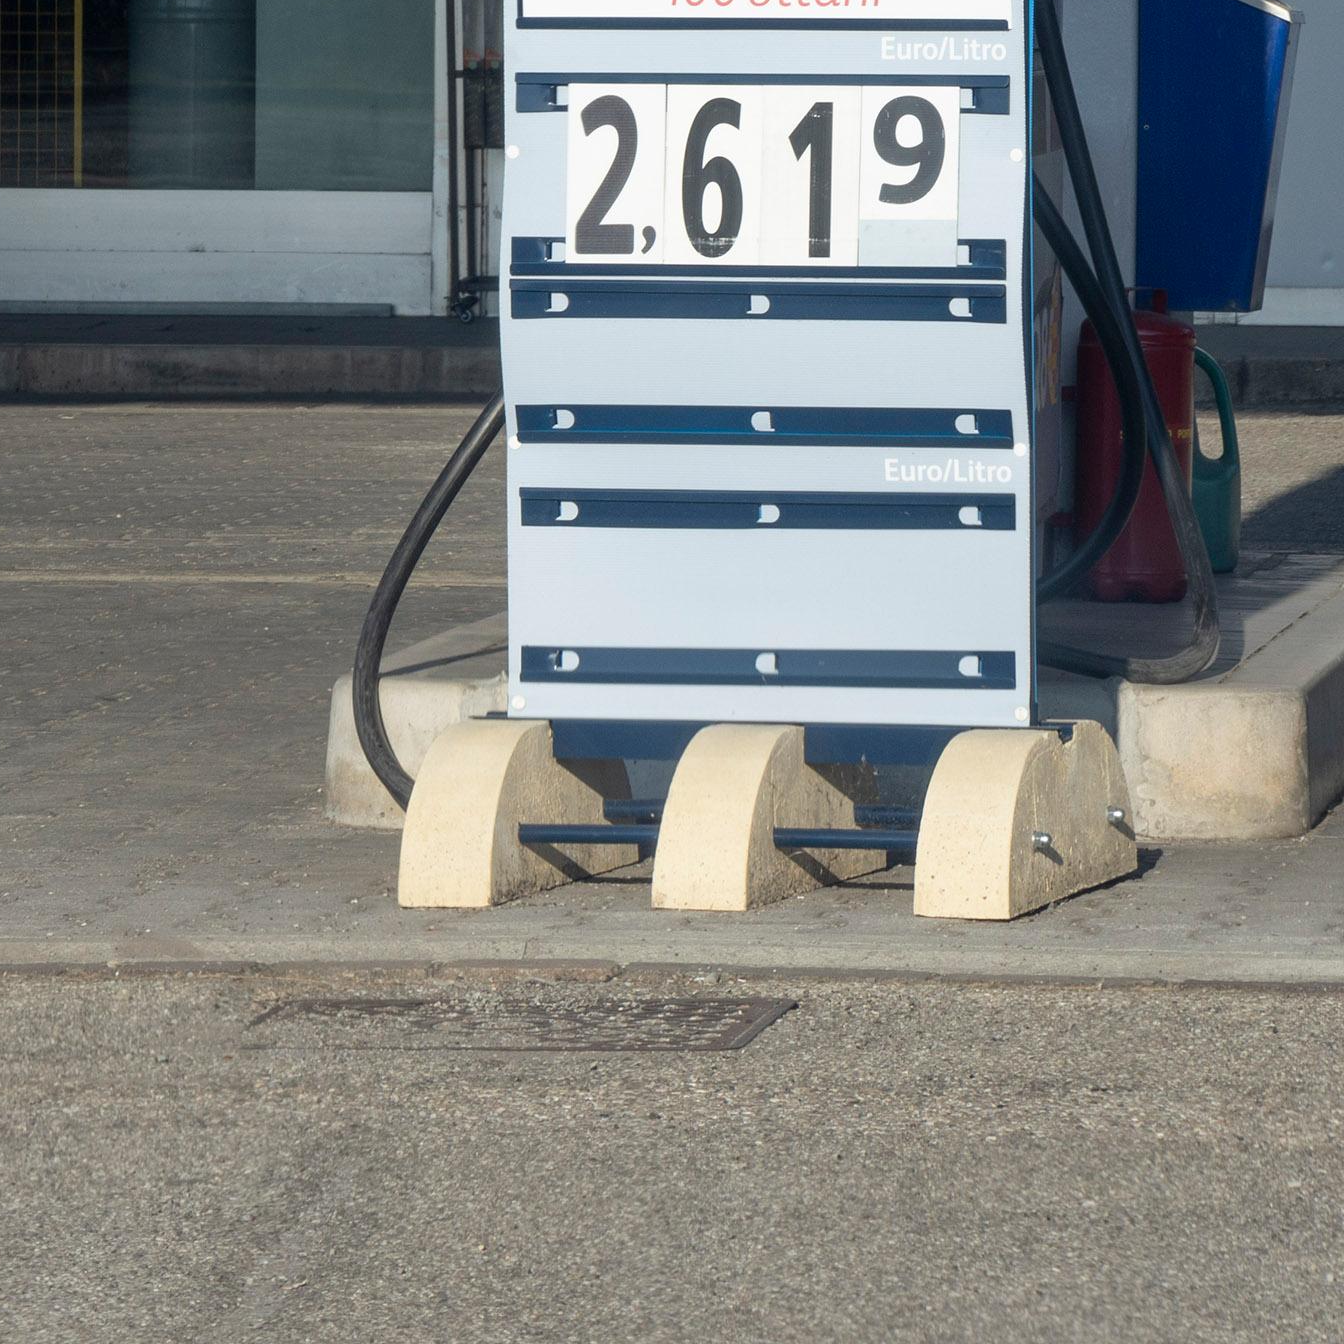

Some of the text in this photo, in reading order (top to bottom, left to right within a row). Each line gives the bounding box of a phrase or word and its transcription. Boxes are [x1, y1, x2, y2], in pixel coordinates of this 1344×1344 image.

[880, 36, 1008, 63] Euro/Litro
[574, 94, 946, 259] 2,619
[883, 458, 1013, 485] Euro/Litro
